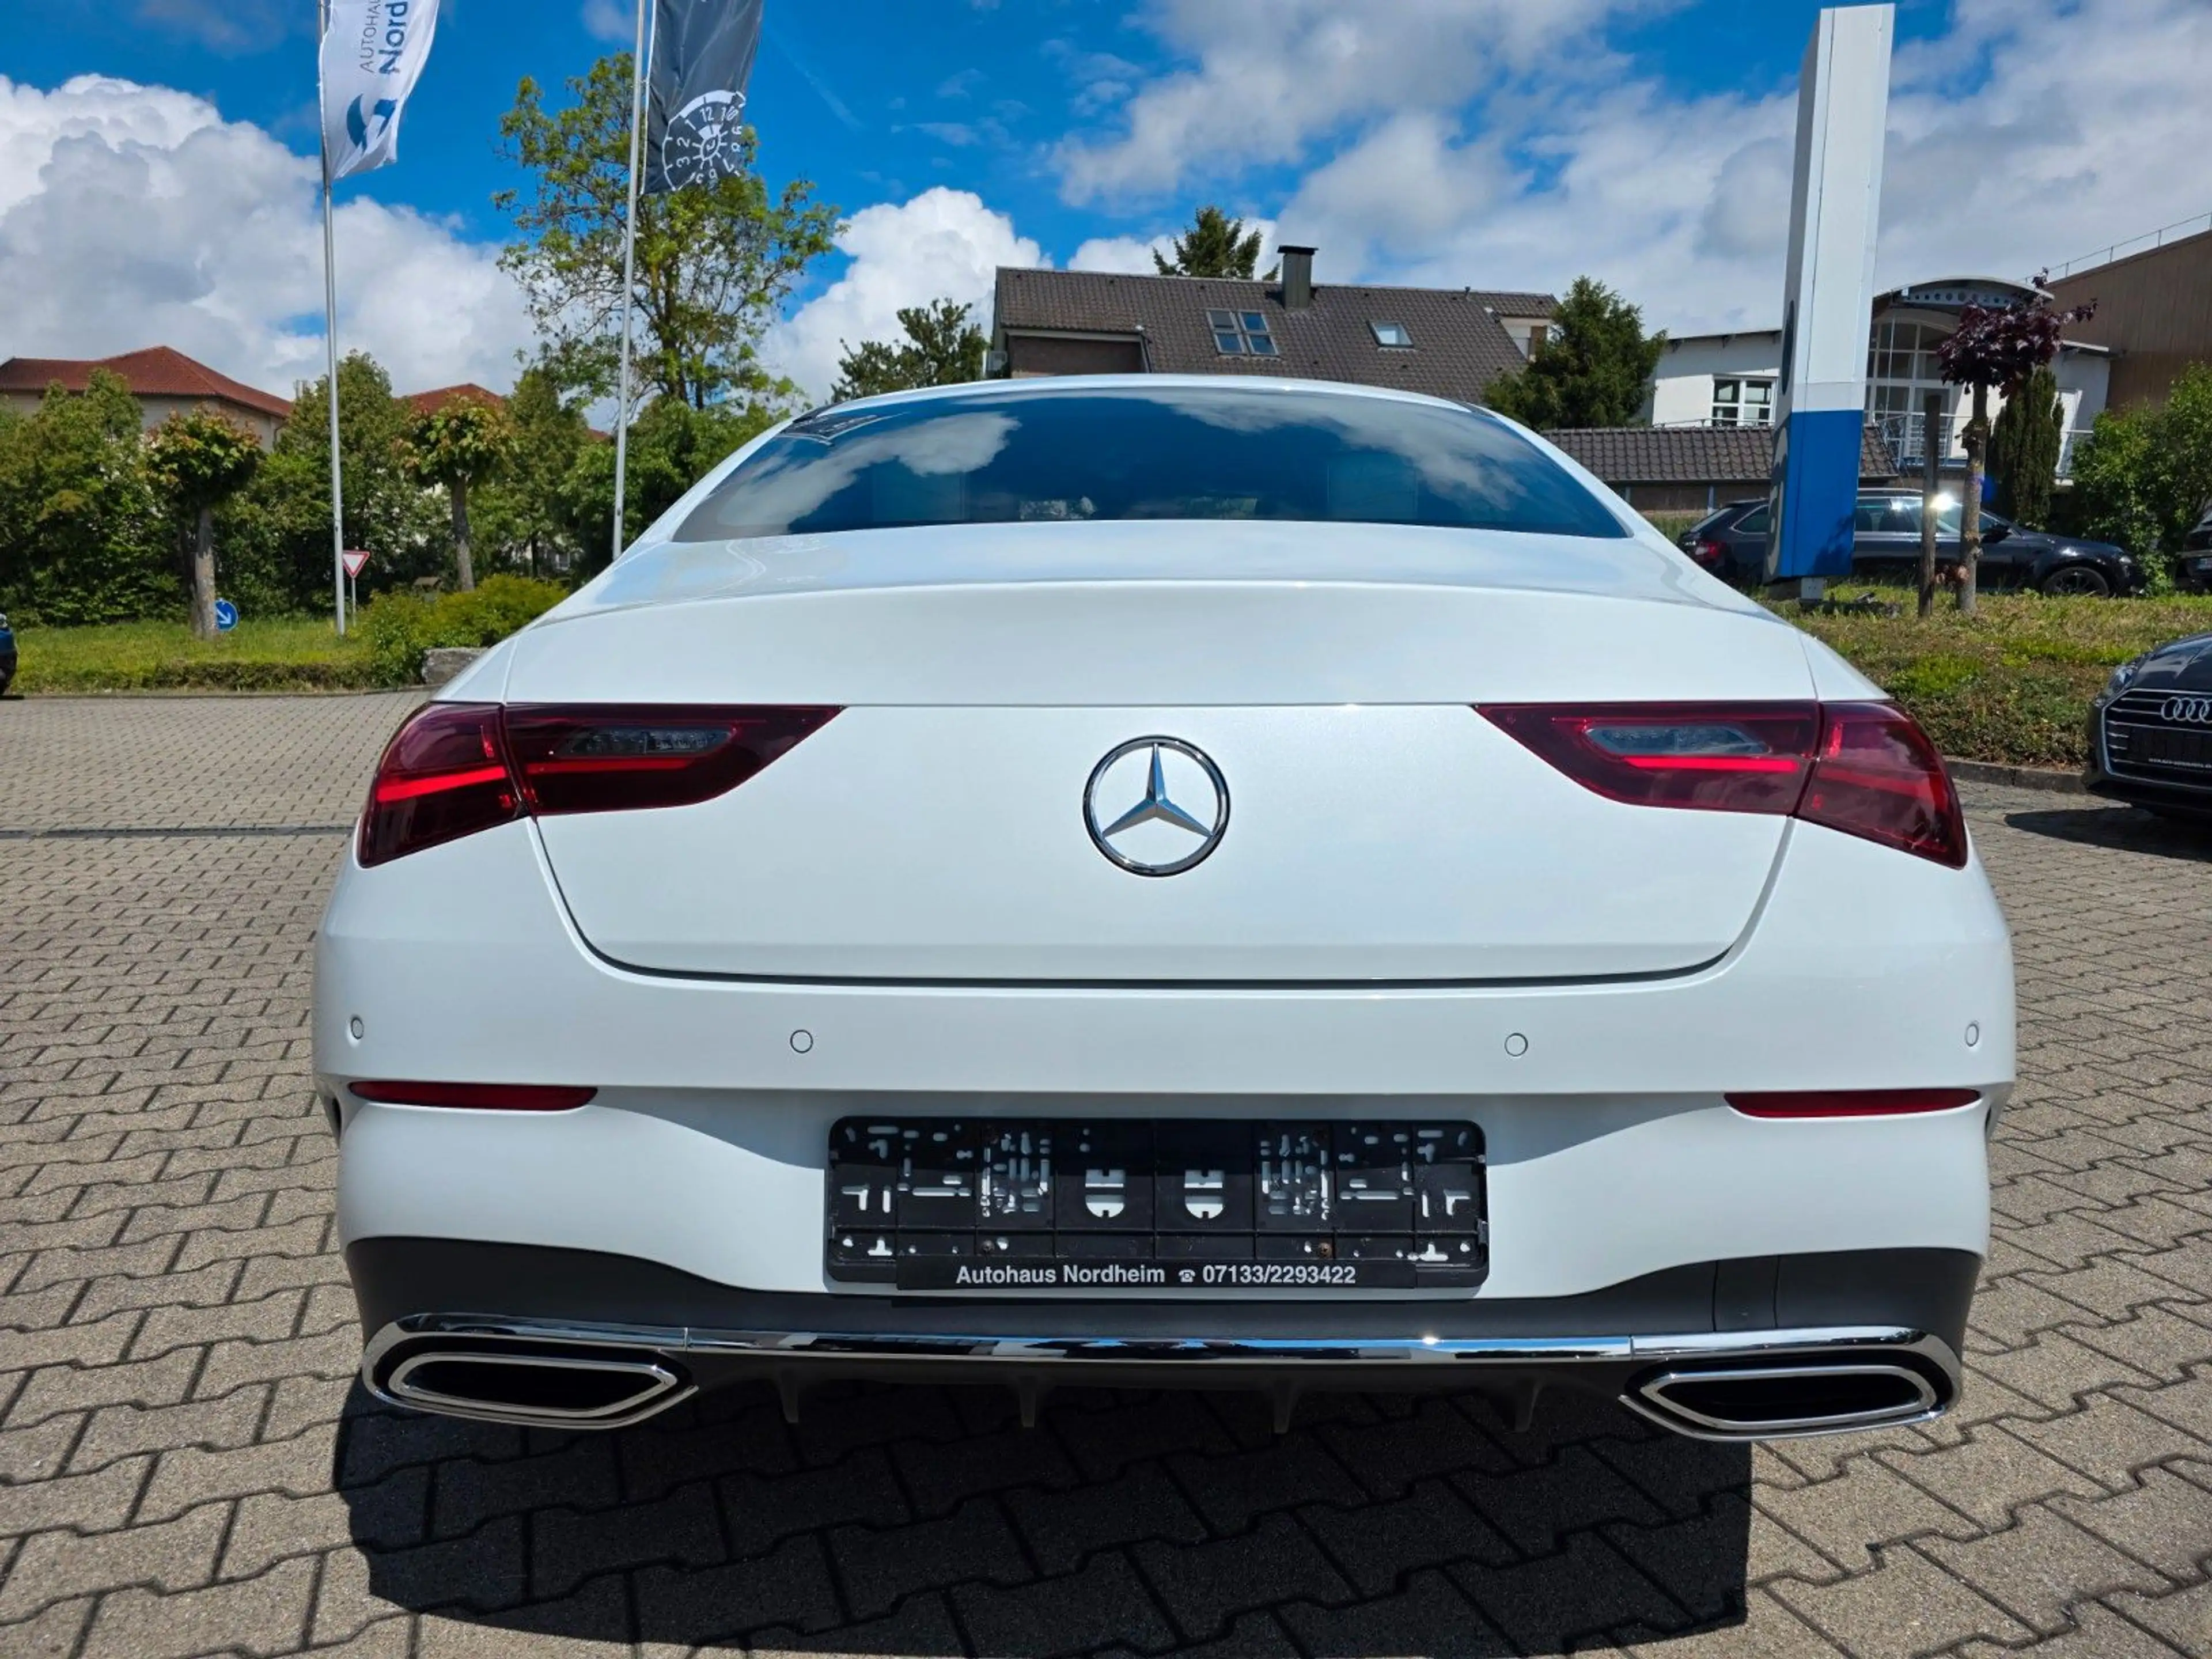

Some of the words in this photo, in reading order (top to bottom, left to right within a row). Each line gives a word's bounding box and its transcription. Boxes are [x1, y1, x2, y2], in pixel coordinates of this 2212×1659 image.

[676, 137, 691, 148] 2
[676, 156, 691, 168] 3
[956, 1265, 1056, 1283] Autohaus
[1063, 1264, 1165, 1283] Nordheim
[1202, 1264, 1356, 1284] 07133/2293422
